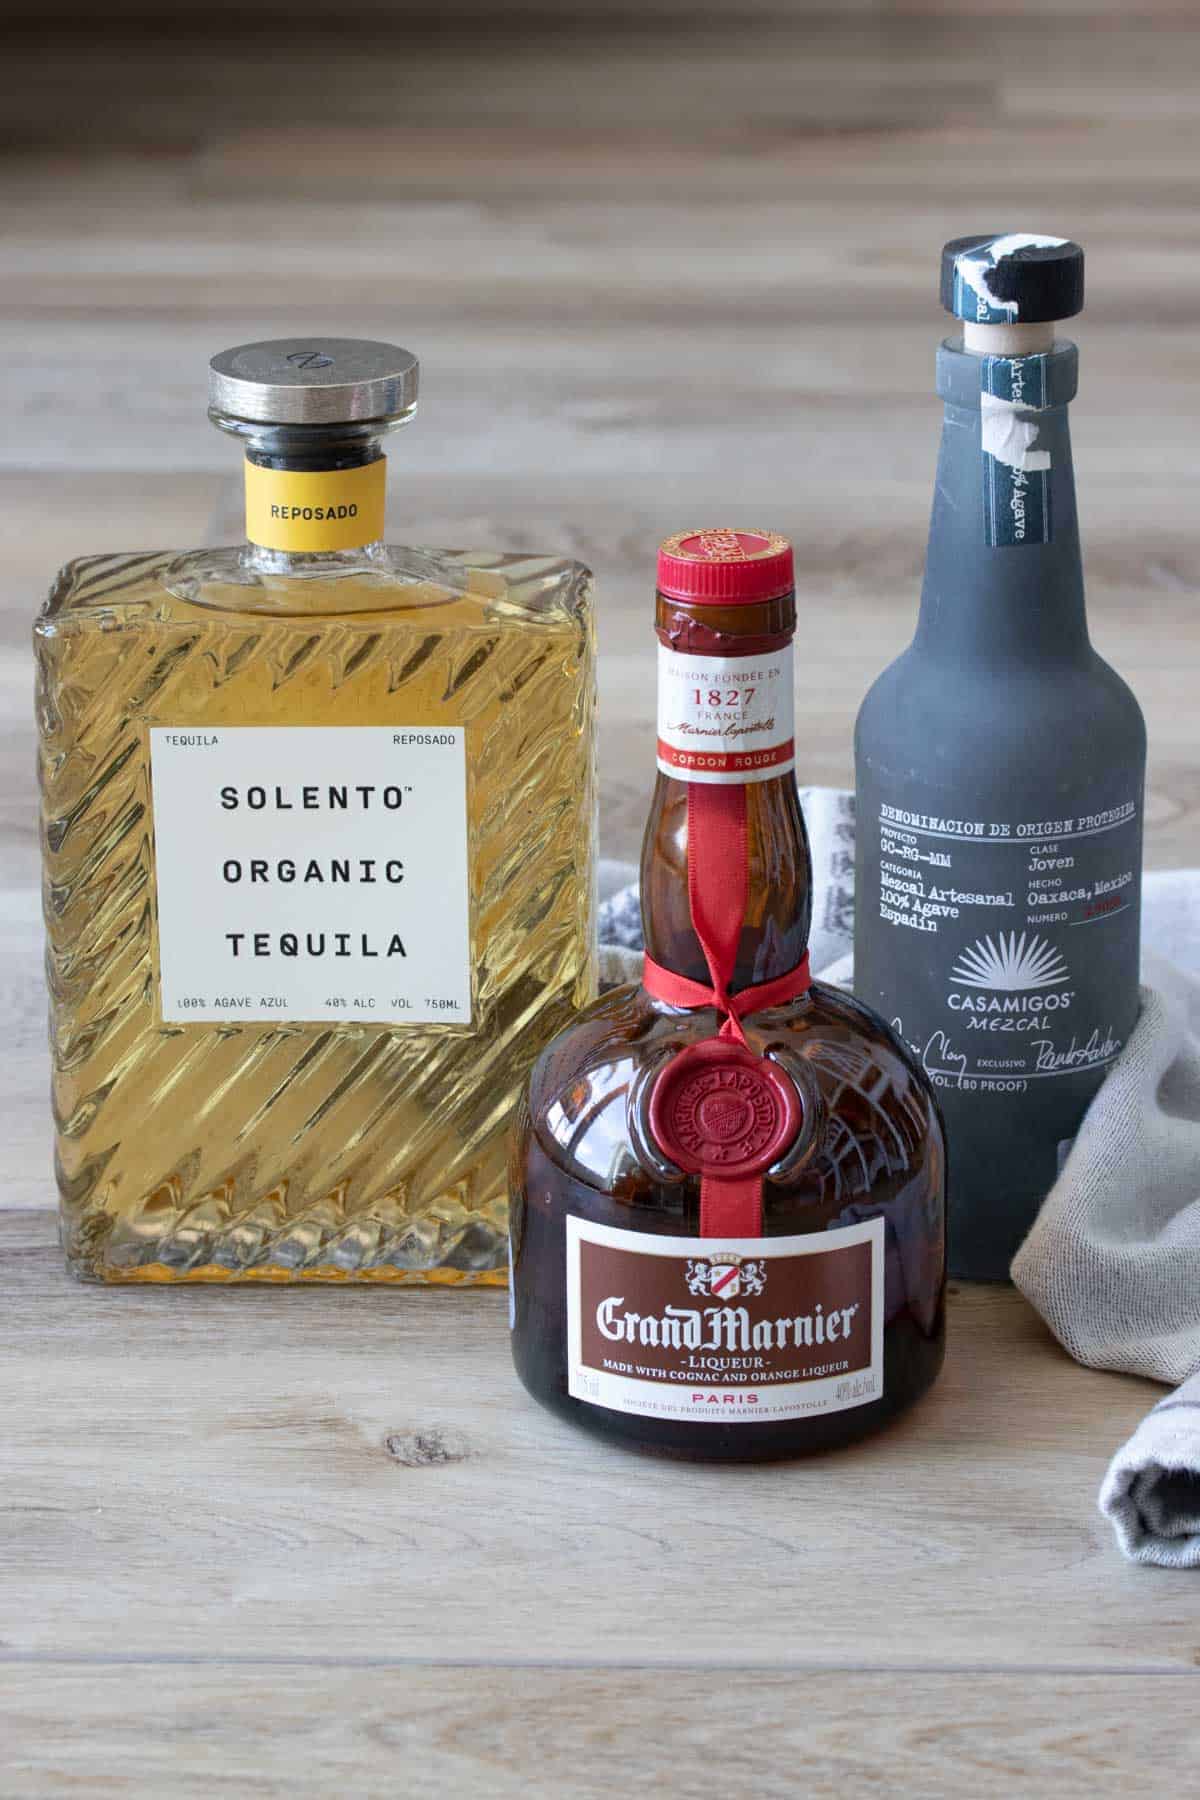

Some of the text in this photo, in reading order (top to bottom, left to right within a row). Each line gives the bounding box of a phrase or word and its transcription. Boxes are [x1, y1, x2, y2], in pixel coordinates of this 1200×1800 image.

[271, 503, 357, 520] REPOSADO
[1010, 488, 1028, 538] Agave
[694, 688, 756, 706] 1827
[697, 711, 749, 721] FRANCE
[165, 735, 218, 745] TEQUILA
[392, 735, 456, 745] REPOSADO
[671, 752, 777, 767] CORDON ROUGE
[880, 801, 1135, 837] DENOMINACION DE ORIGEN PROTEGIDA
[880, 826, 917, 845] PROYECTO
[1029, 845, 1059, 855] CLASE
[223, 860, 404, 884] ORGANIC
[880, 860, 922, 880] CATEGORIA
[1028, 856, 1075, 872] Joven
[880, 871, 1016, 907] Mezcal Artesanal
[1027, 888, 1092, 906] Oaxaca,
[1094, 872, 1132, 896] Mexico
[1028, 878, 1062, 889] HECHO
[880, 887, 959, 918] 100% Agave
[1027, 912, 1068, 924] NUMERO
[225, 934, 407, 957] TEQUILA
[178, 997, 289, 1008] 100% AGAVE AZUL
[326, 998, 462, 1010] 40% ALC VOL 750ML
[966, 1015, 1052, 1031] MEZCAL
[976, 1058, 1026, 1068] EXCLUSIVO
[981, 1079, 1028, 1092] PROOF)
[596, 1296, 856, 1352] Grand Marnier
[603, 1358, 849, 1382] MADE WITH COGNAC AND ORANGE LIQUEUR
[692, 1393, 759, 1404] PARIS
